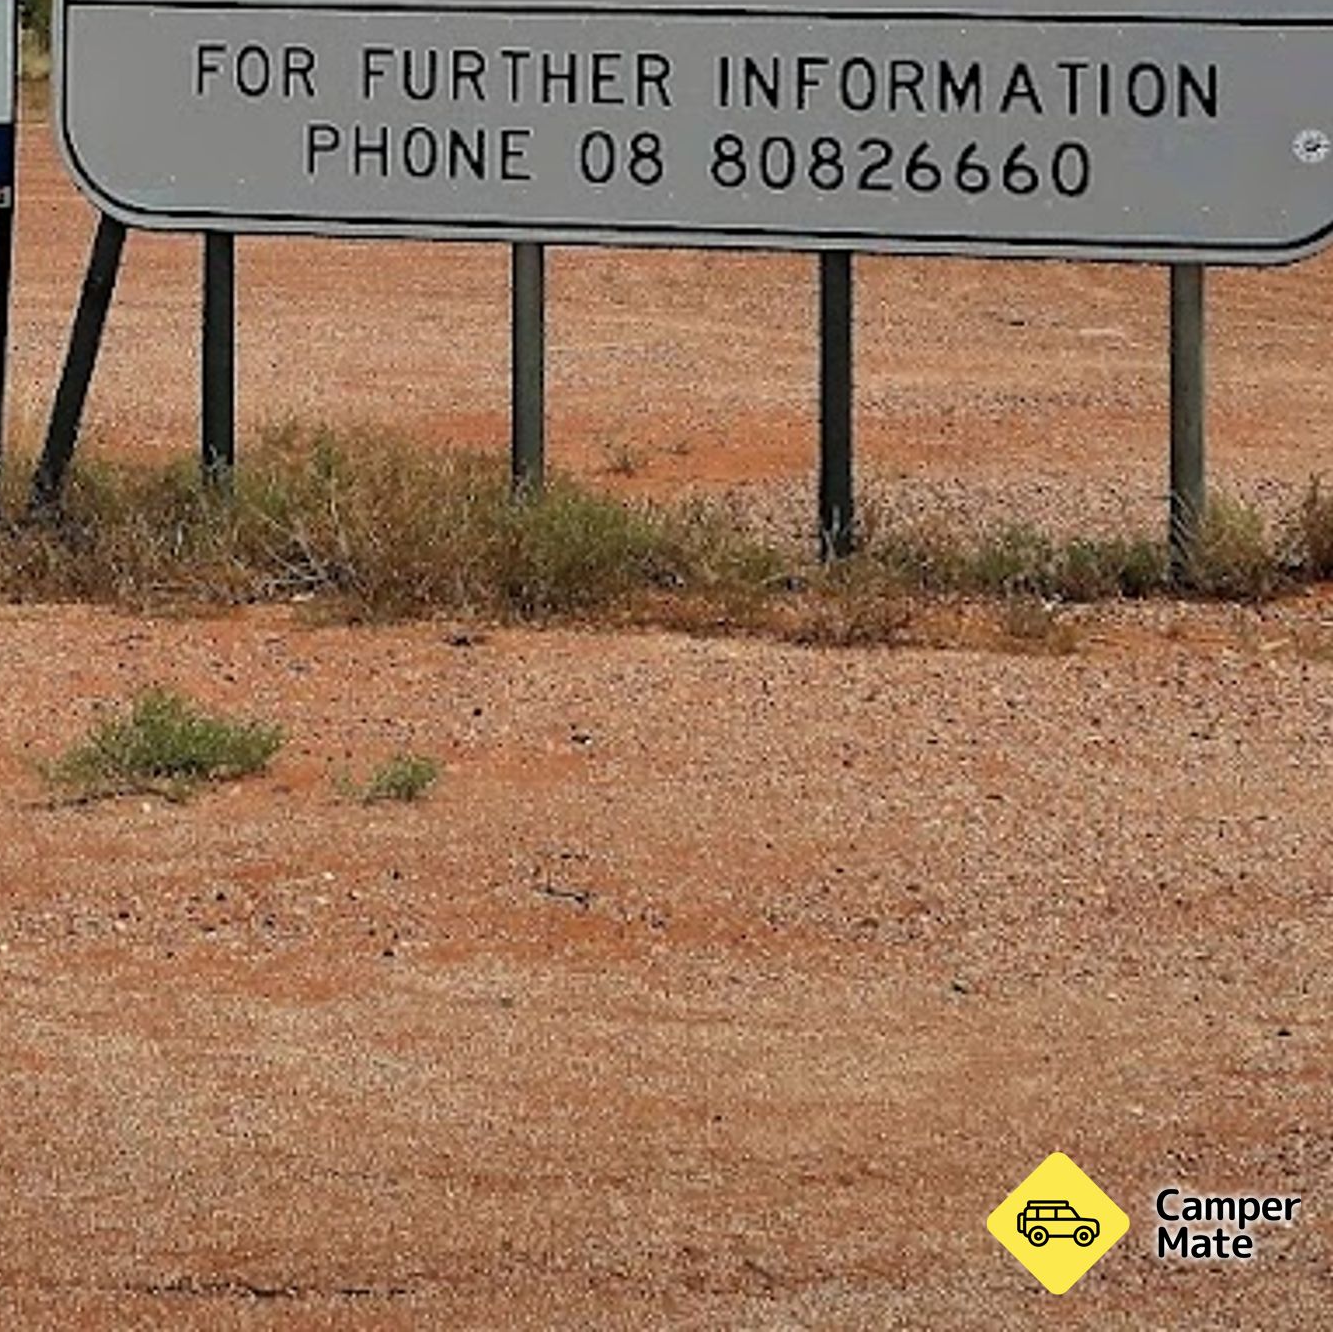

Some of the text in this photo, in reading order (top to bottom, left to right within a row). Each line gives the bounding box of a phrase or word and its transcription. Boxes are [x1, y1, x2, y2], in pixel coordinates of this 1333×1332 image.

[196, 44, 1218, 118] FOR FURTHER INFORMATION
[307, 124, 1091, 197] PHONE 08 80826660
